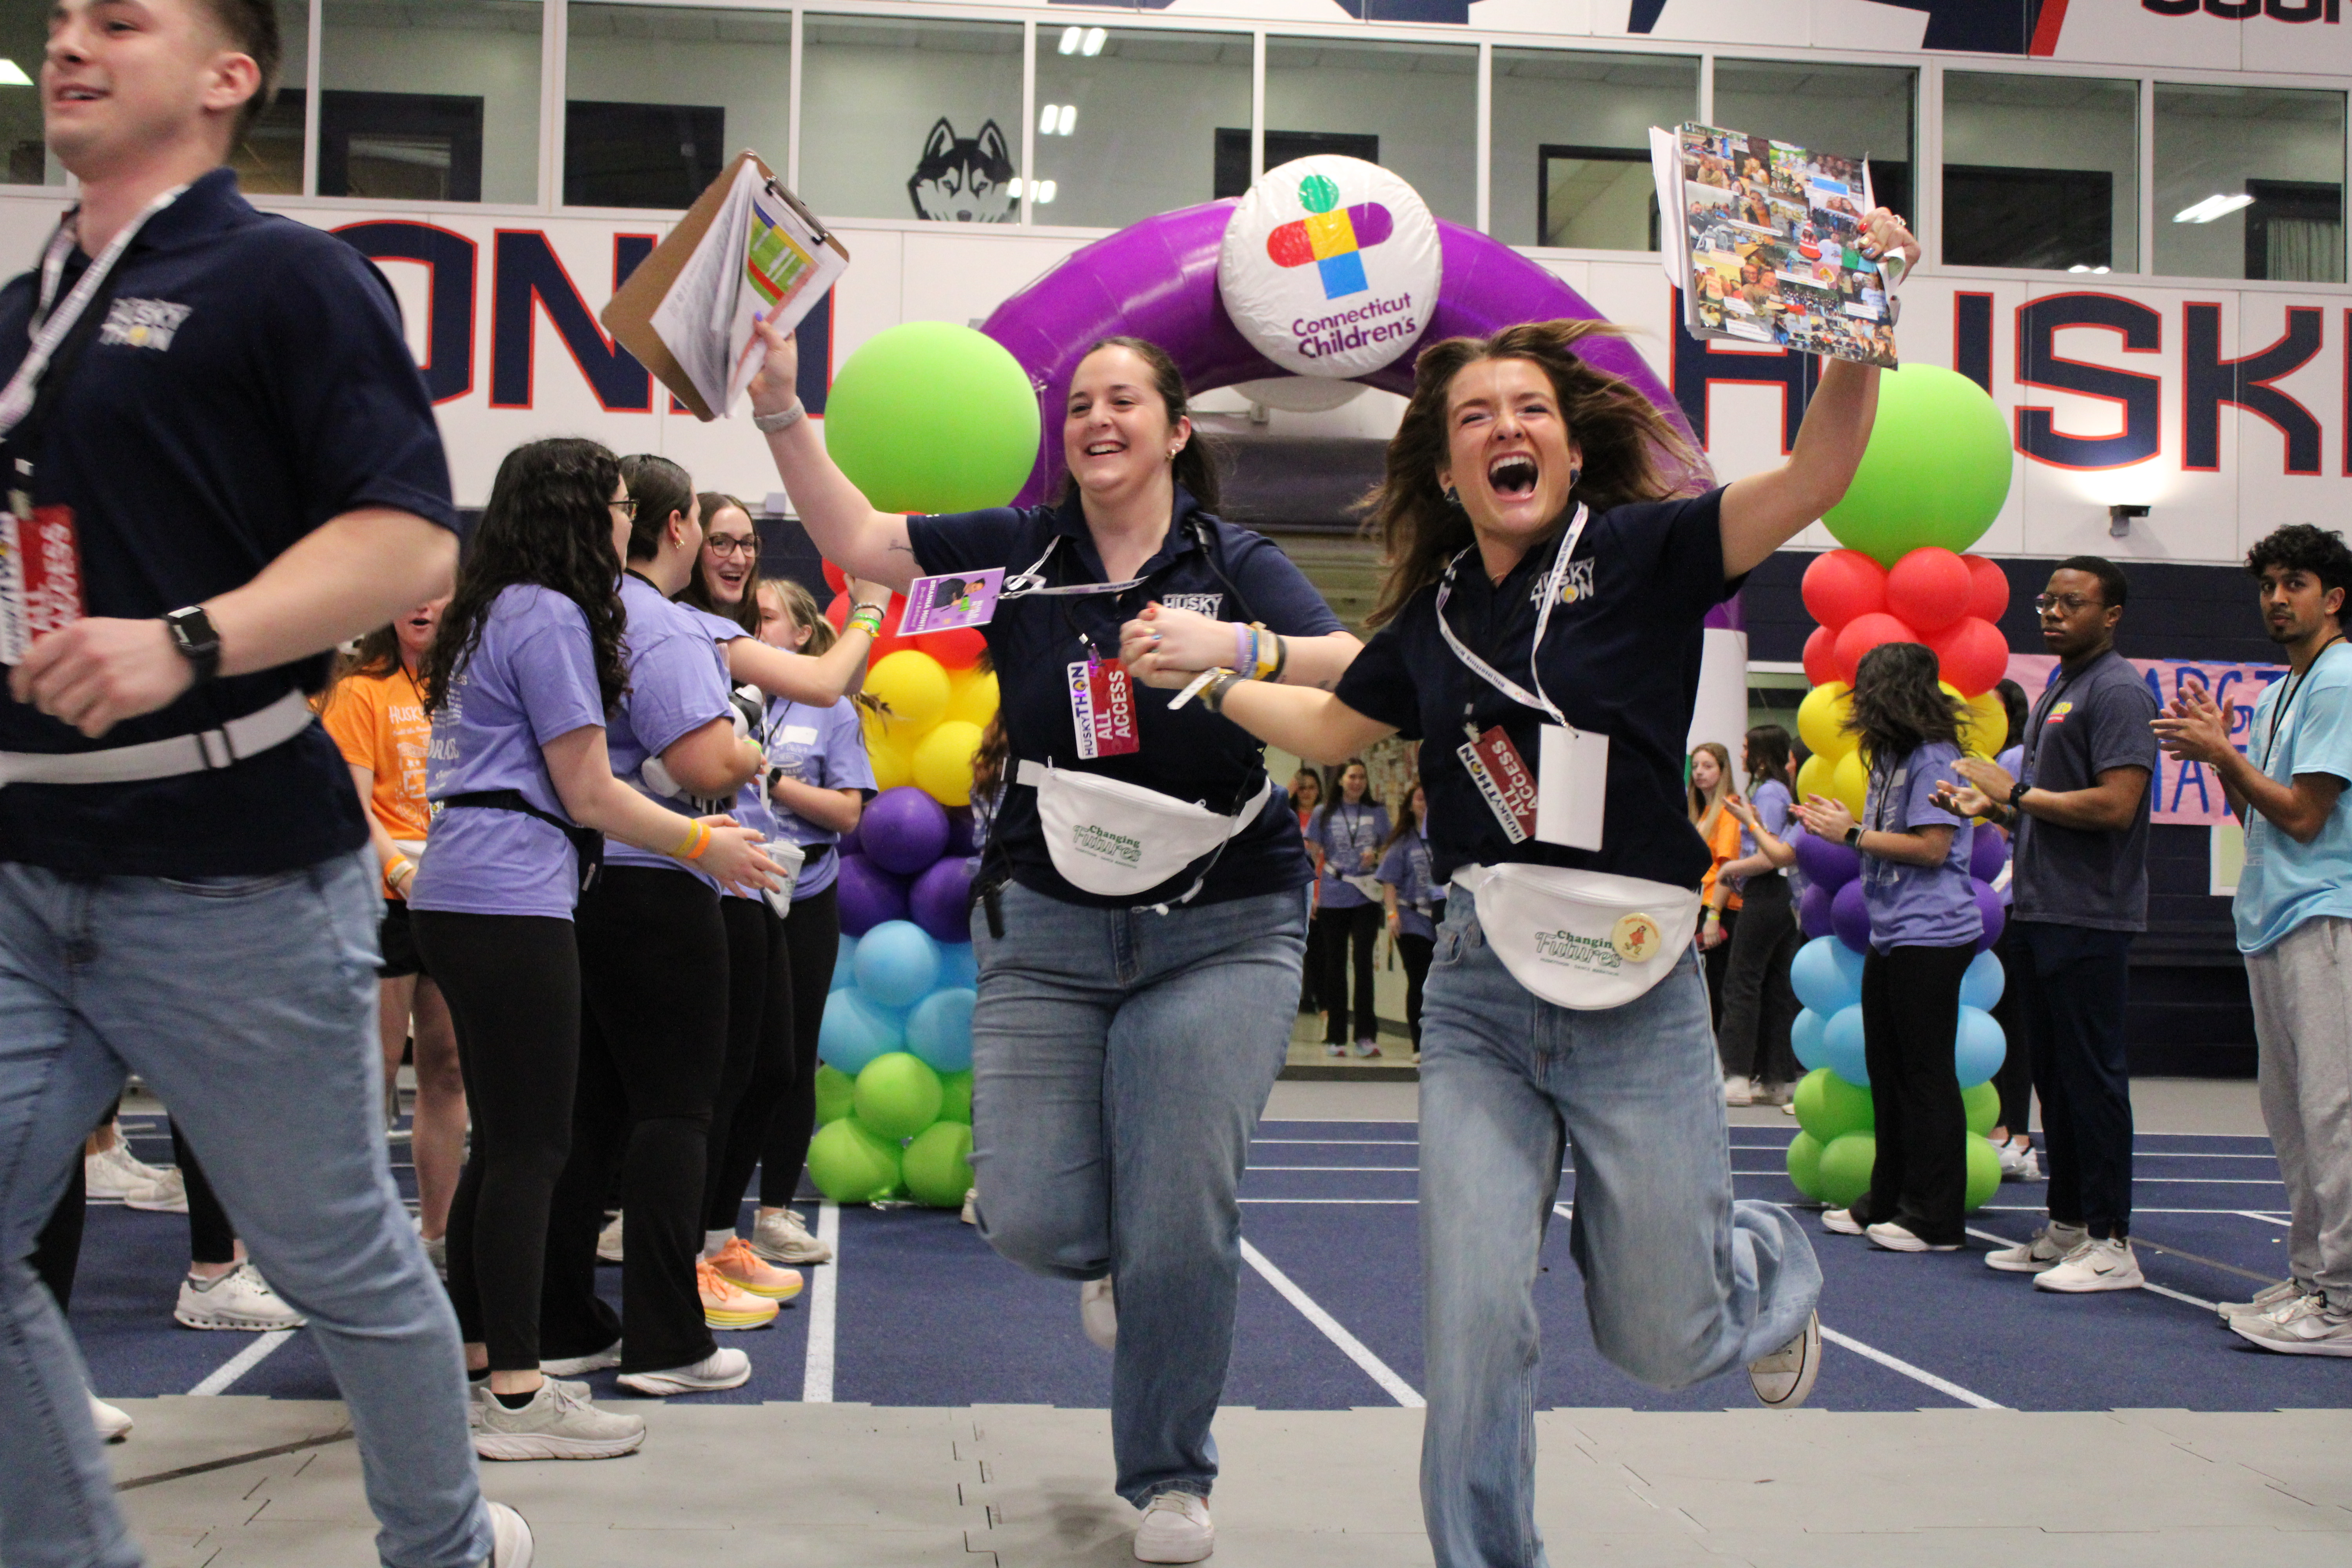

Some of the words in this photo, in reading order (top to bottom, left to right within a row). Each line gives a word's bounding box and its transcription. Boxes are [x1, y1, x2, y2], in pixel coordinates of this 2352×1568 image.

[1292, 292, 1411, 337] Connecticut
[1298, 317, 1416, 358] Children's
[924, 579, 937, 609] BRIANNA
[1162, 593, 1224, 611] HUSKY
[1071, 666, 1094, 755] HUSKYTHON
[1109, 669, 1132, 738] ACCESS
[1096, 708, 1113, 740] ALL
[1491, 739, 1538, 811] ACCESS
[1462, 746, 1522, 841] HUSKYTHON
[1503, 785, 1530, 818] ALL
[1073, 825, 1142, 862] Futures
[1090, 825, 1141, 849] Changing
[1535, 932, 1622, 968] Futures
[1557, 930, 1616, 952] Changin
